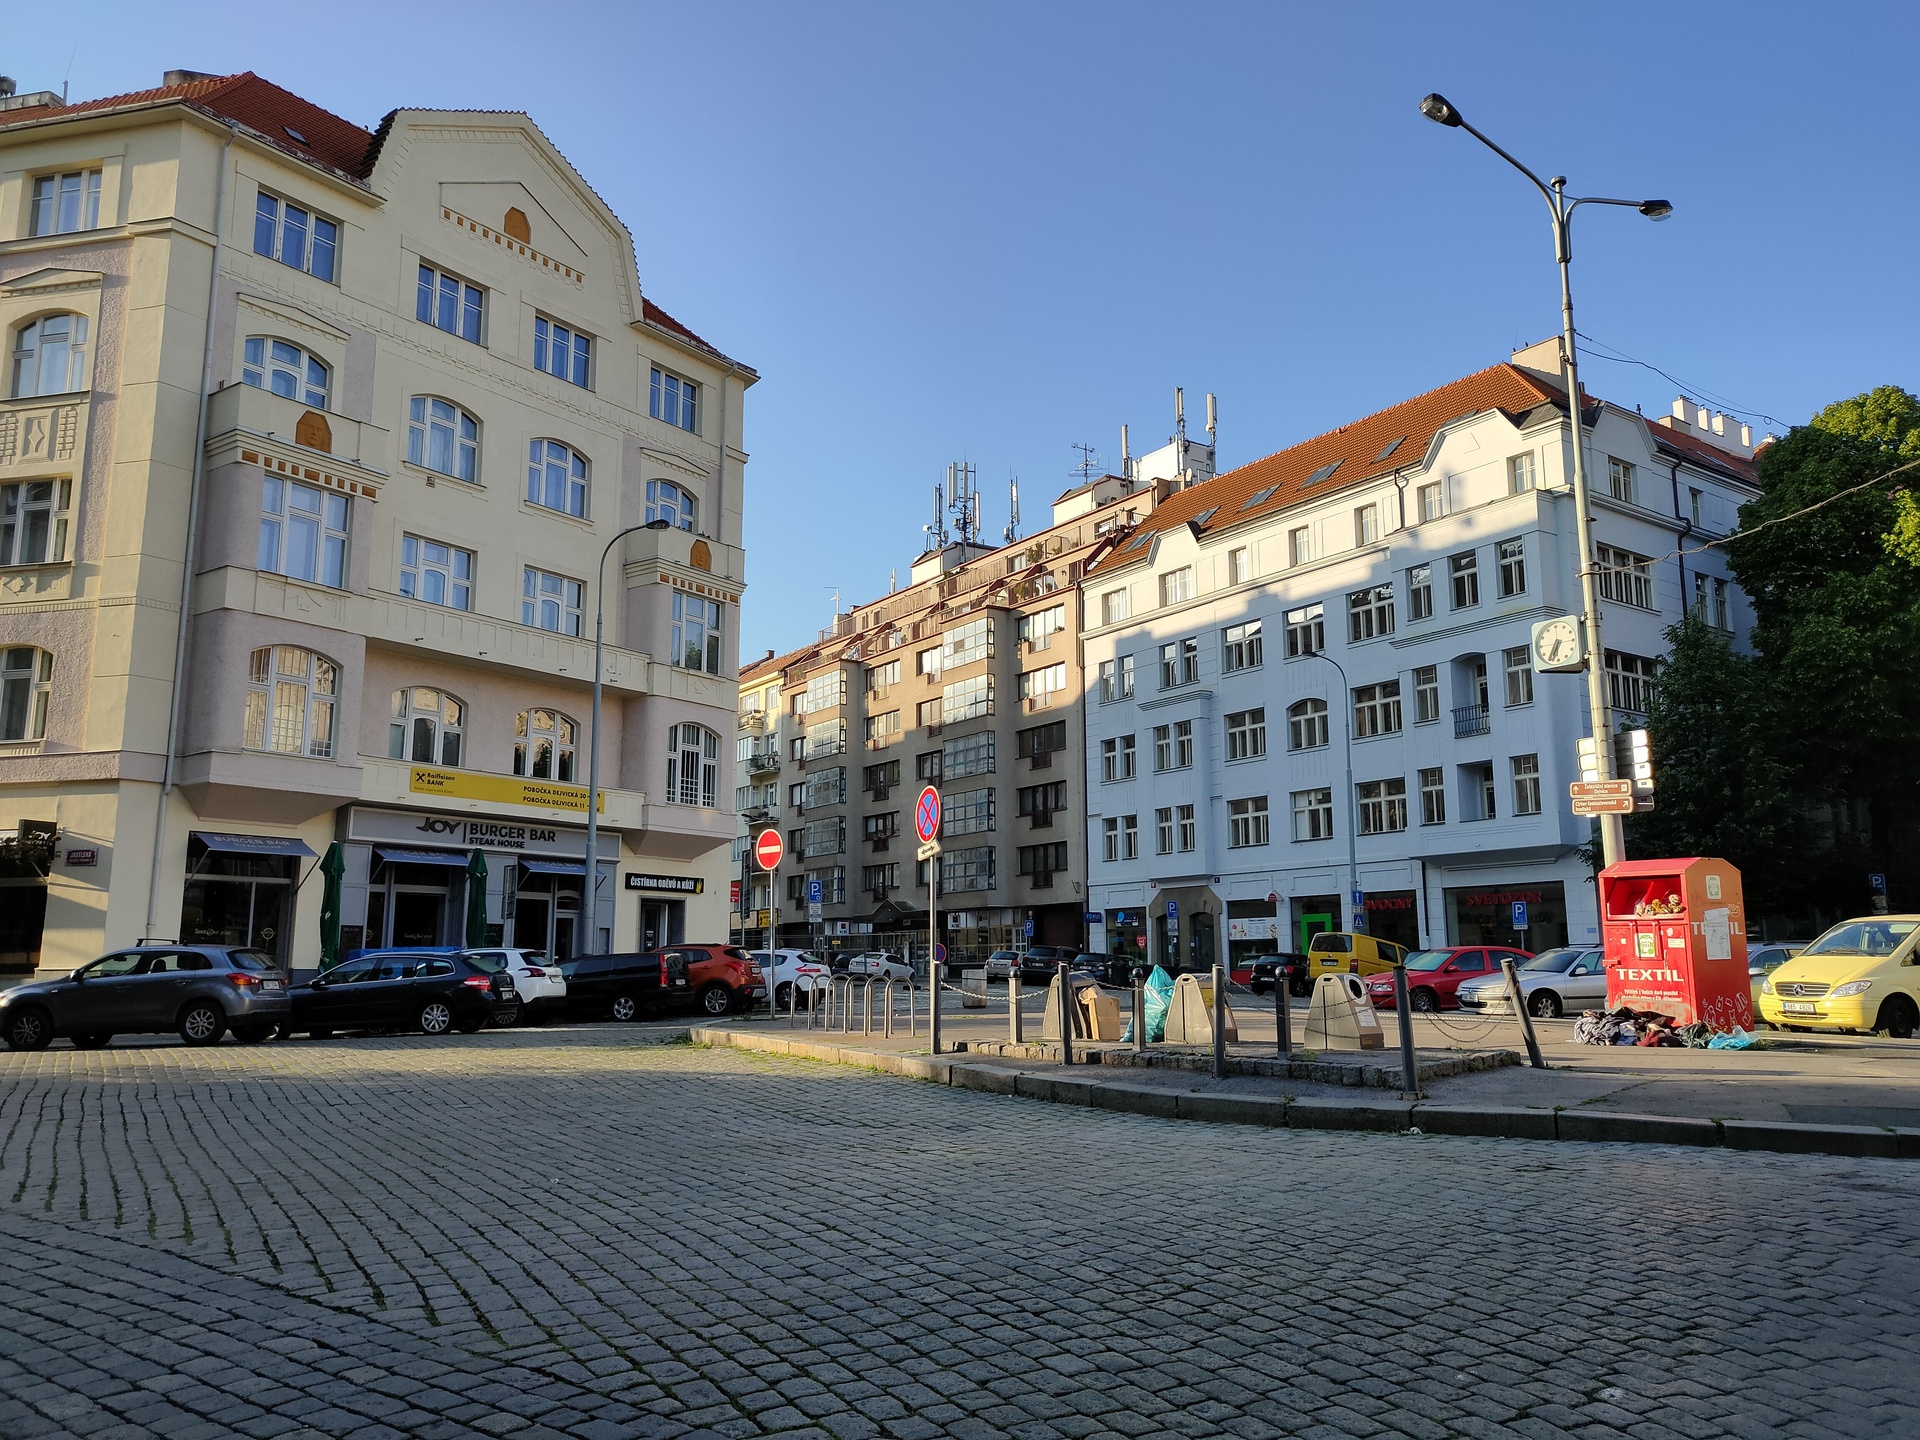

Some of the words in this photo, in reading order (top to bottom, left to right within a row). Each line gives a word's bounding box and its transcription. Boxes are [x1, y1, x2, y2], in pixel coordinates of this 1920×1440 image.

[427, 772, 456, 781] Raiffeisen
[523, 785, 552, 795] POBOČKA
[552, 789, 579, 799] DEJVICKÁ
[522, 795, 551, 805] POBOČKA
[552, 799, 578, 808] DEJVICKÁ
[415, 817, 462, 834] JOY
[469, 823, 526, 839] BURGER
[529, 829, 556, 842] BAR
[213, 836, 263, 845] BURGER
[469, 837, 496, 846] STEAK
[498, 839, 526, 848] HOUSE
[630, 876, 658, 887] ČISTÍRNA
[658, 878, 677, 889] ODĚVŮ
[677, 881, 681, 889] A
[1872, 876, 1881, 887] P
[811, 883, 819, 895] P
[1169, 903, 1175, 913] P
[1515, 904, 1523, 917] P
[1026, 922, 1032, 930] P
[1615, 968, 1685, 982] TEXTIL
